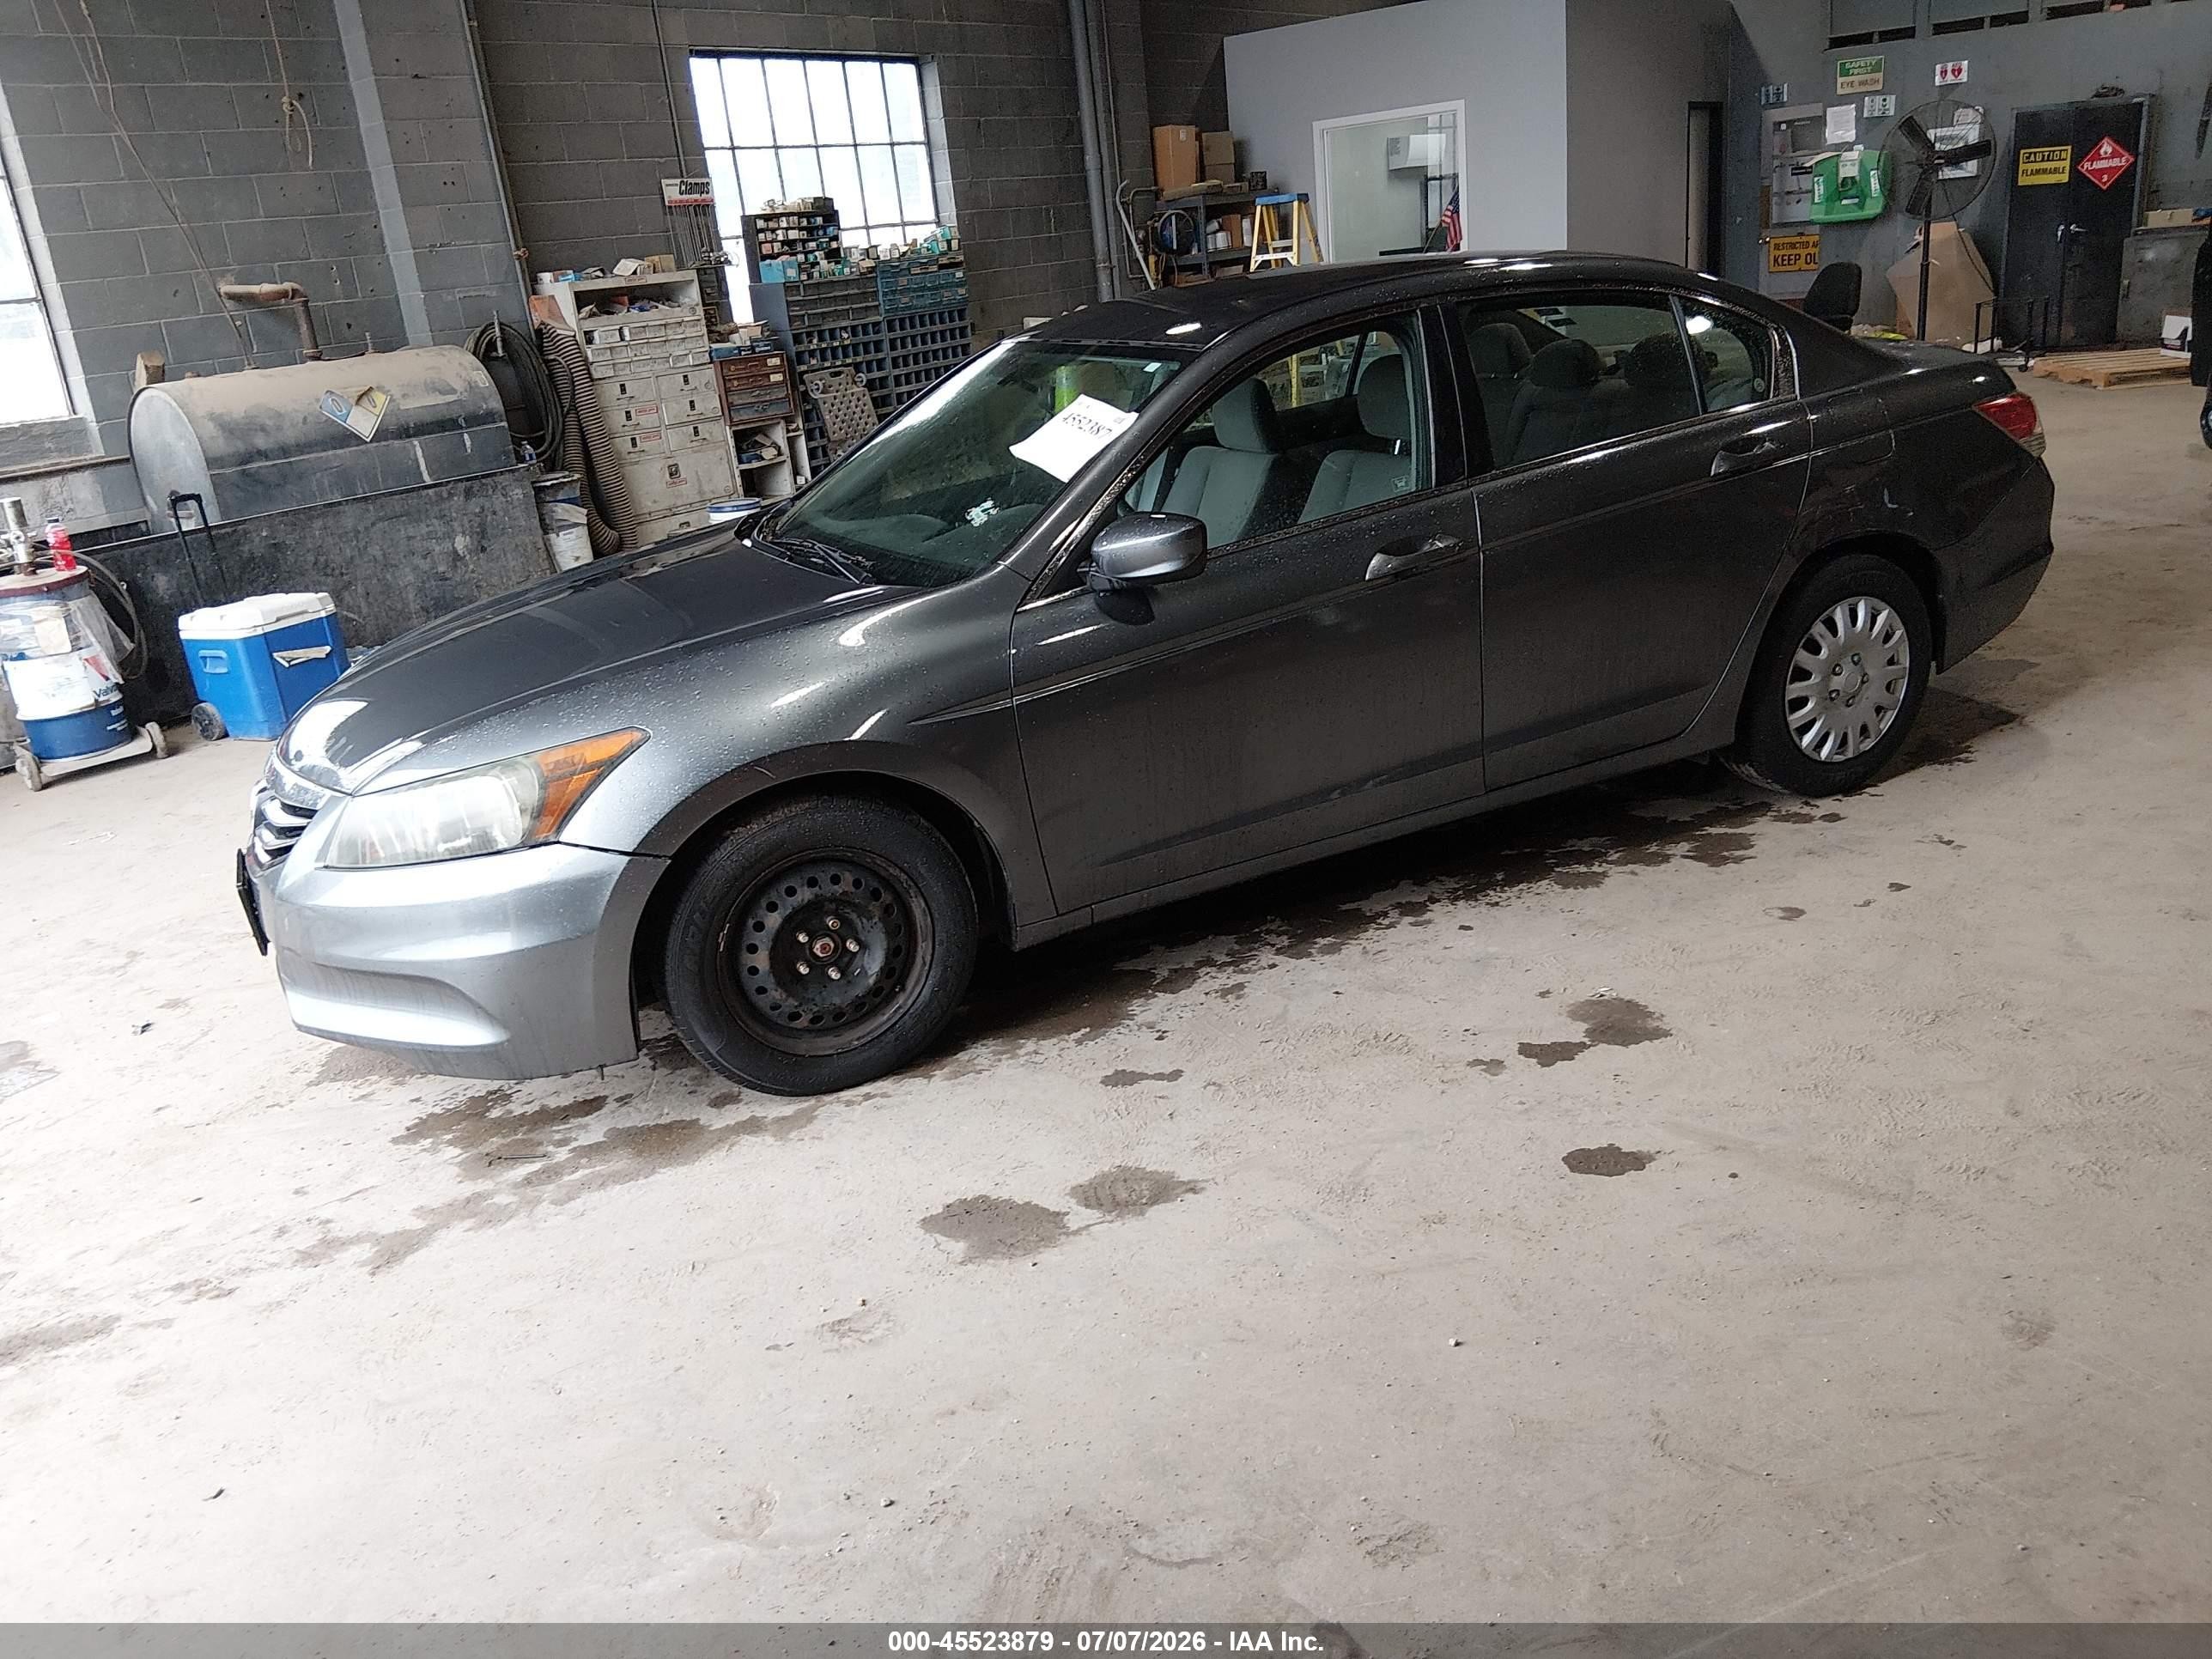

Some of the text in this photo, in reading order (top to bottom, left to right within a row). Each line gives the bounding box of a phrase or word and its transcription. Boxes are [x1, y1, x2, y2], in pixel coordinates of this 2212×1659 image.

[1845, 58, 1877, 69] SAFETY
[1840, 77, 1881, 89] EYE WASH
[2023, 150, 2068, 163] CAUTION
[2084, 157, 2127, 171] FLAMMABLE
[2021, 166, 2067, 177] FLAMMABLE
[678, 179, 711, 197] Clamps
[1773, 240, 1810, 252] RESTRICTED
[1772, 252, 1802, 267] KEEP
